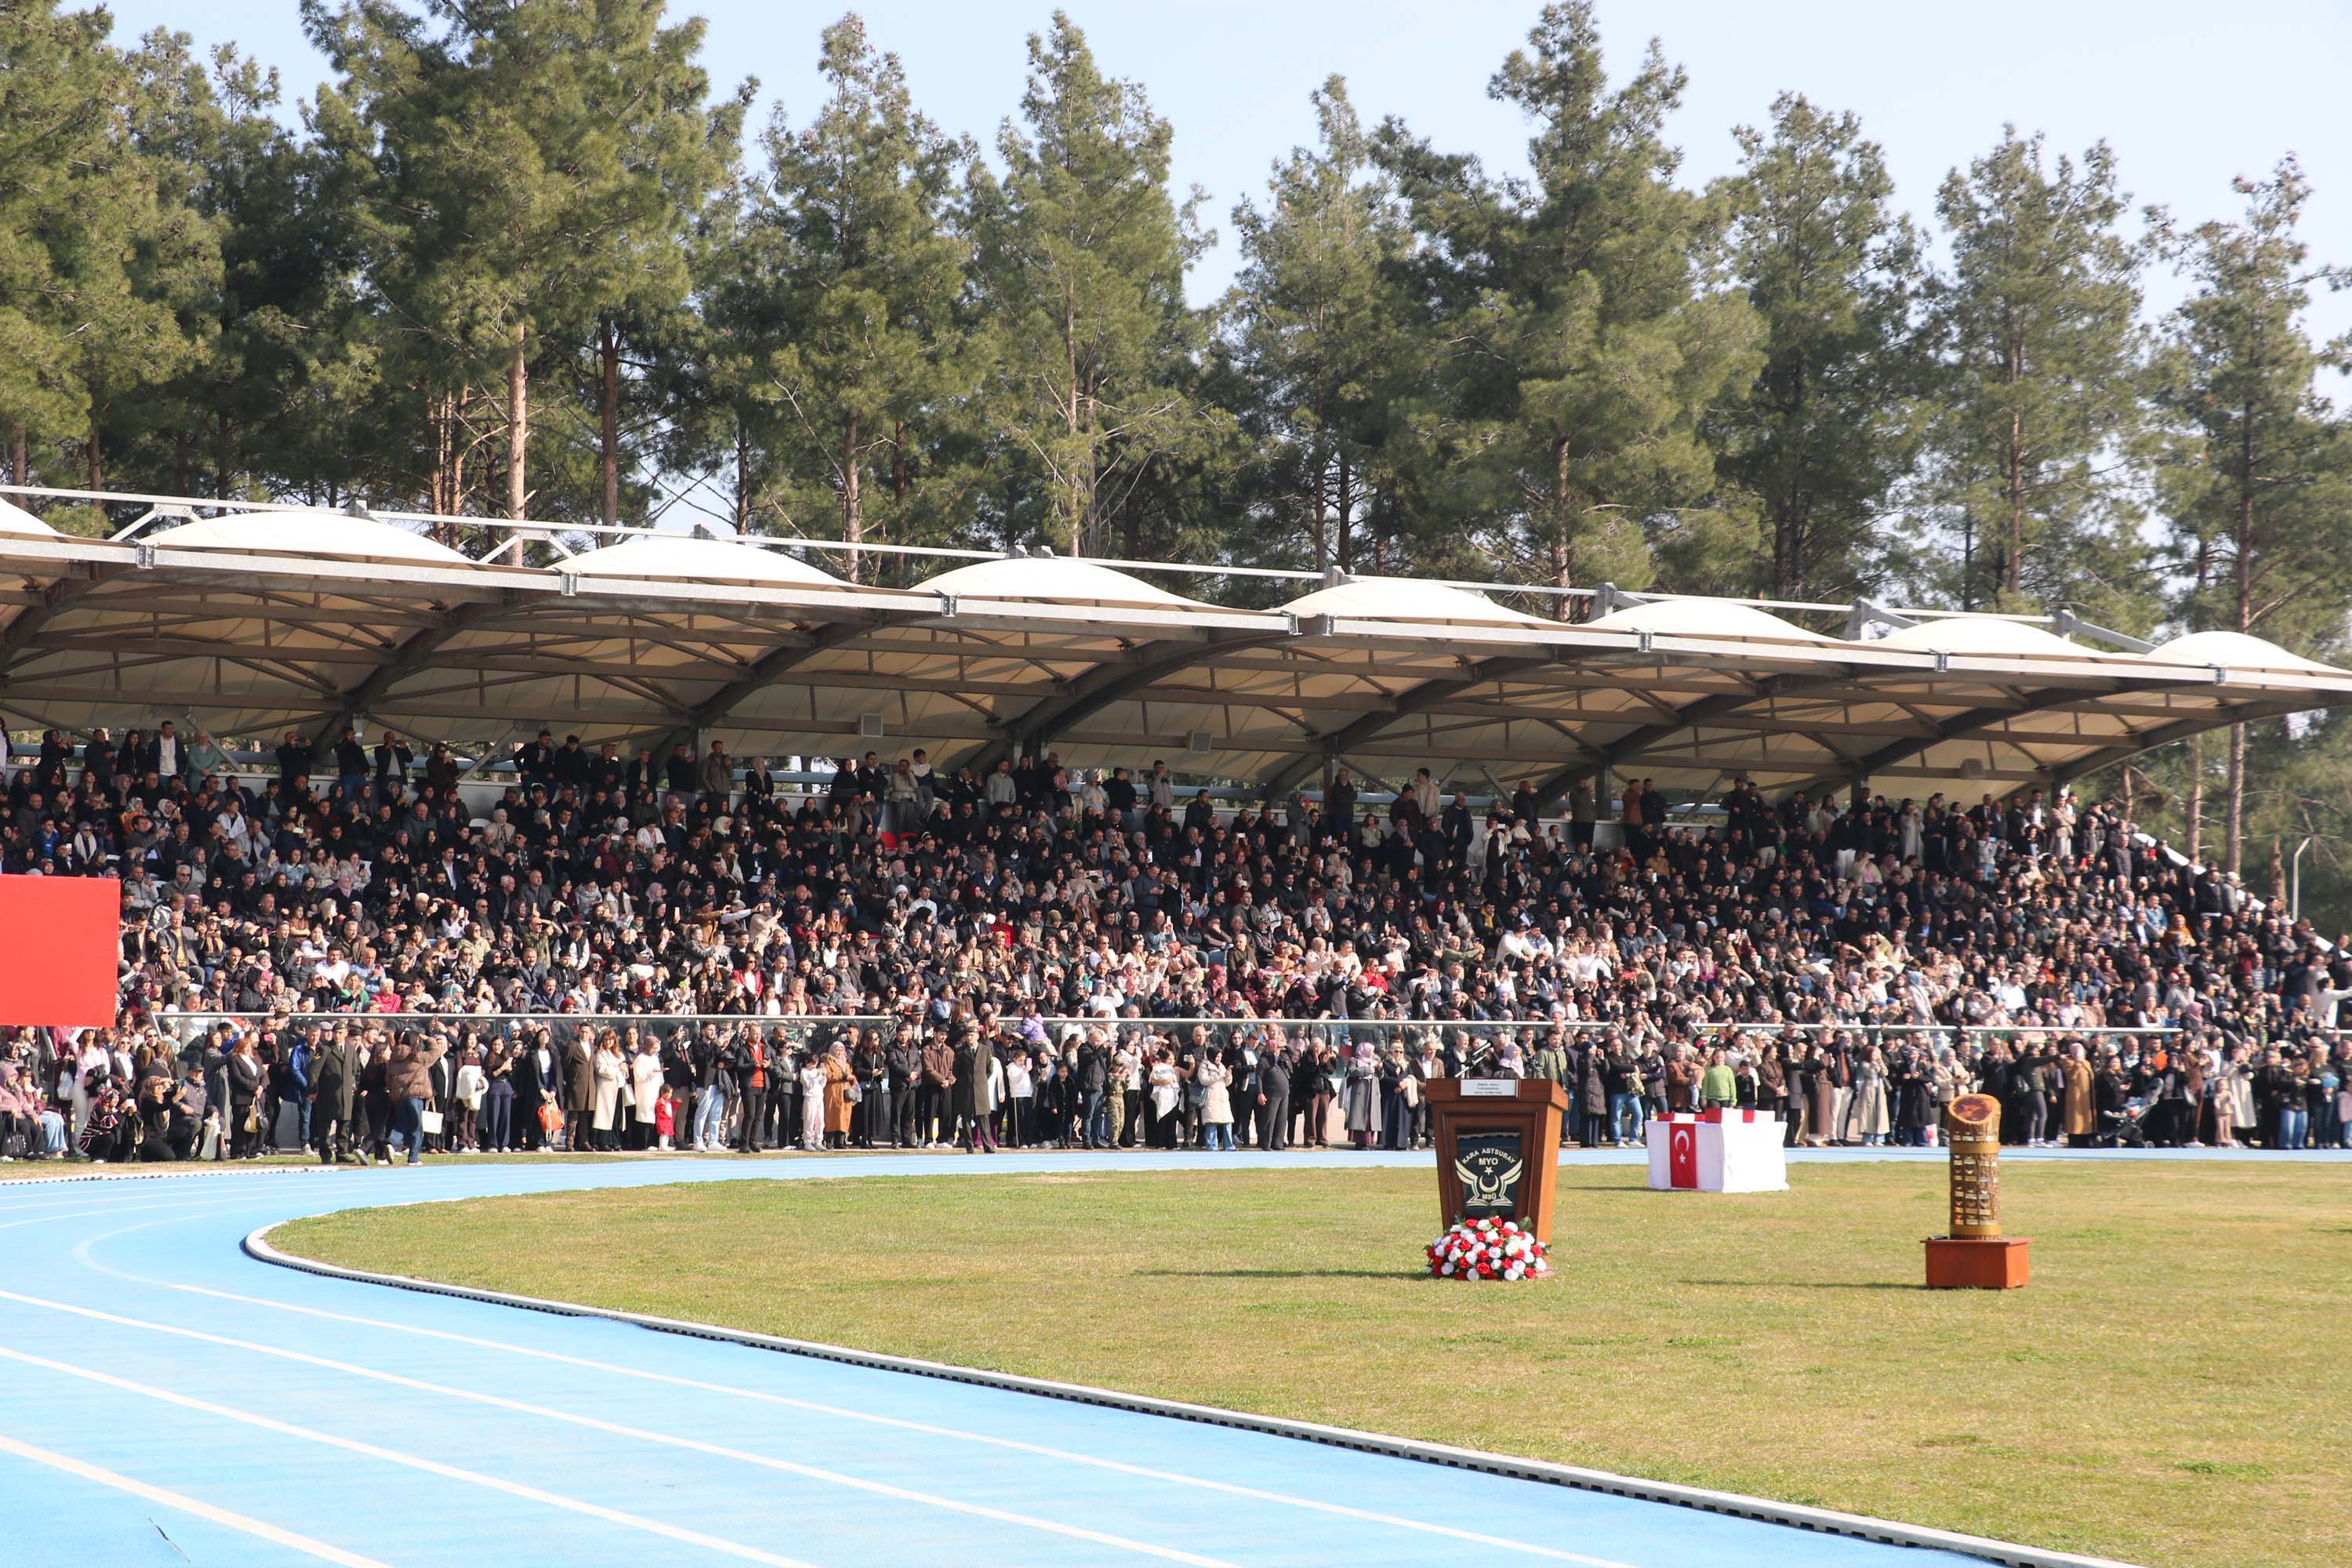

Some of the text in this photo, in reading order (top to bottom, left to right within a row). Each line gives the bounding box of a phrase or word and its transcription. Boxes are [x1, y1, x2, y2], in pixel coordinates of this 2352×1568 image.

[1461, 1148, 1516, 1164] KARA ASTSUBAY
[1479, 1157, 1498, 1166] MYO
